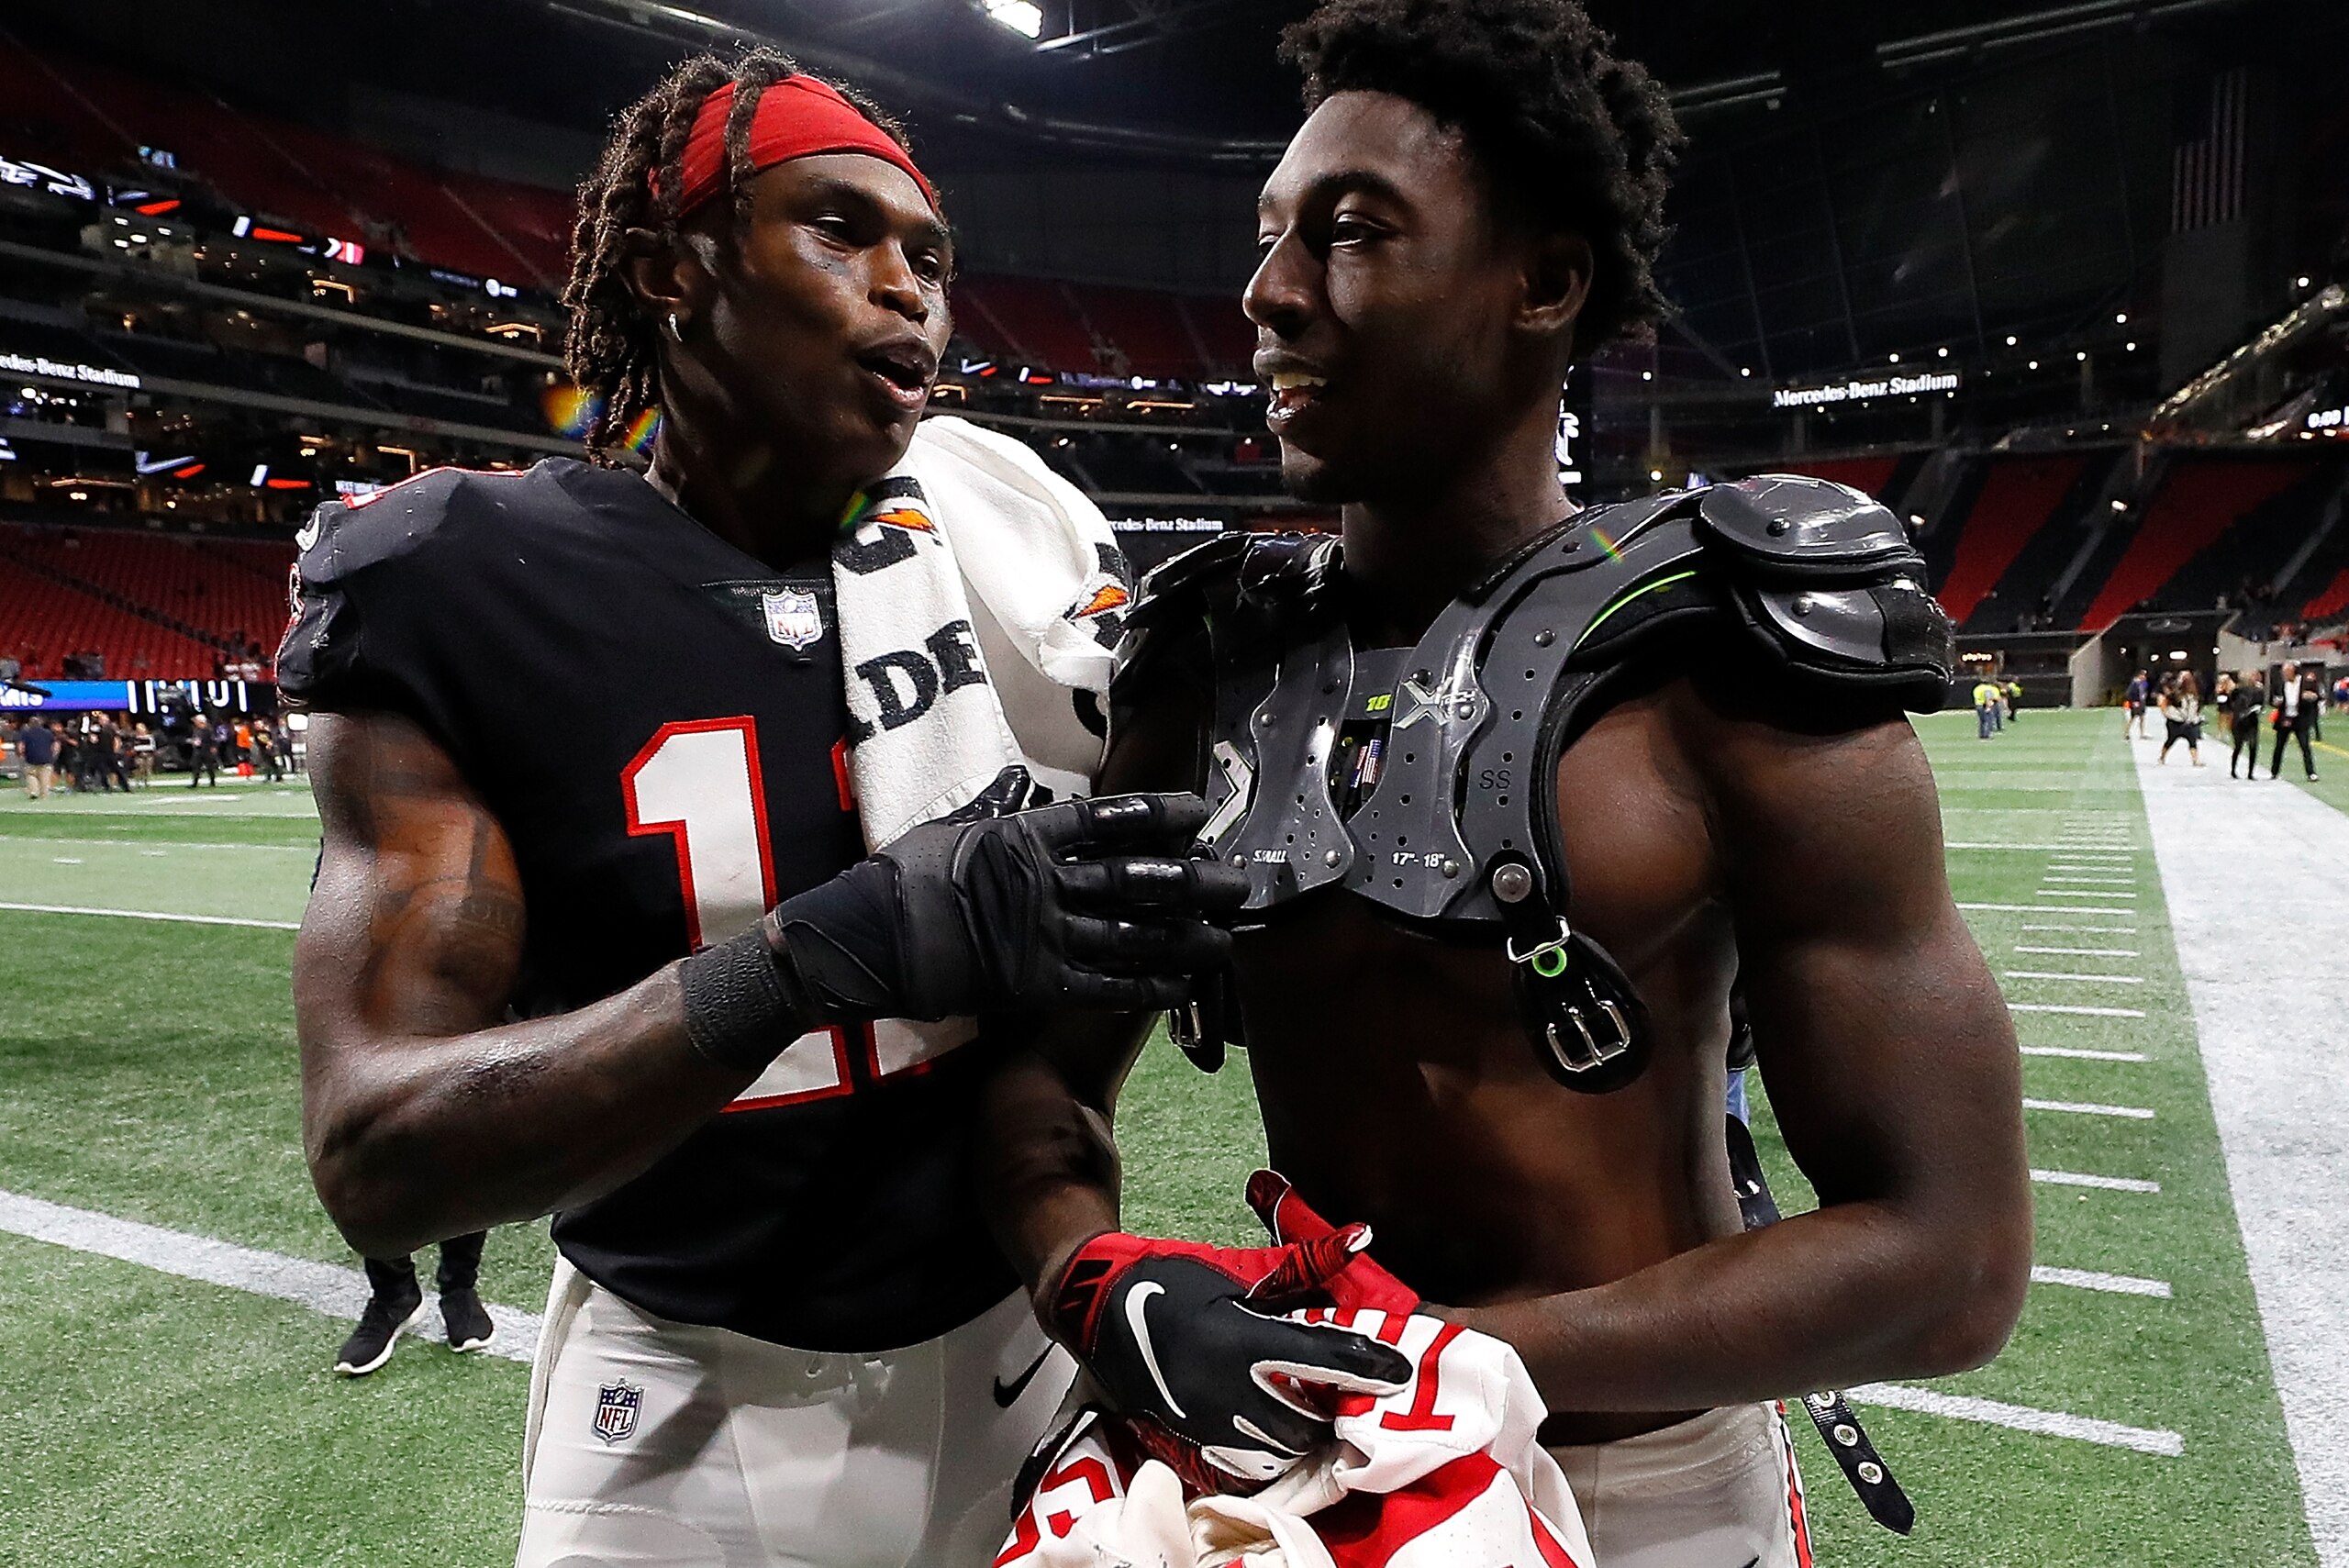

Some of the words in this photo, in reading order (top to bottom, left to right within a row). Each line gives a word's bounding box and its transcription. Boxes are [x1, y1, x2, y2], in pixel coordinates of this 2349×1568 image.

[77, 364, 139, 388] Stadium
[1774, 381, 1888, 406] Mercedes-Benz
[1889, 373, 1958, 395] Stadium
[1175, 517, 1223, 531] Stadium
[846, 619, 989, 750] DE
[1479, 769, 1511, 790] SS
[1252, 850, 1287, 863] SMALL
[598, 1407, 630, 1432] NFL
